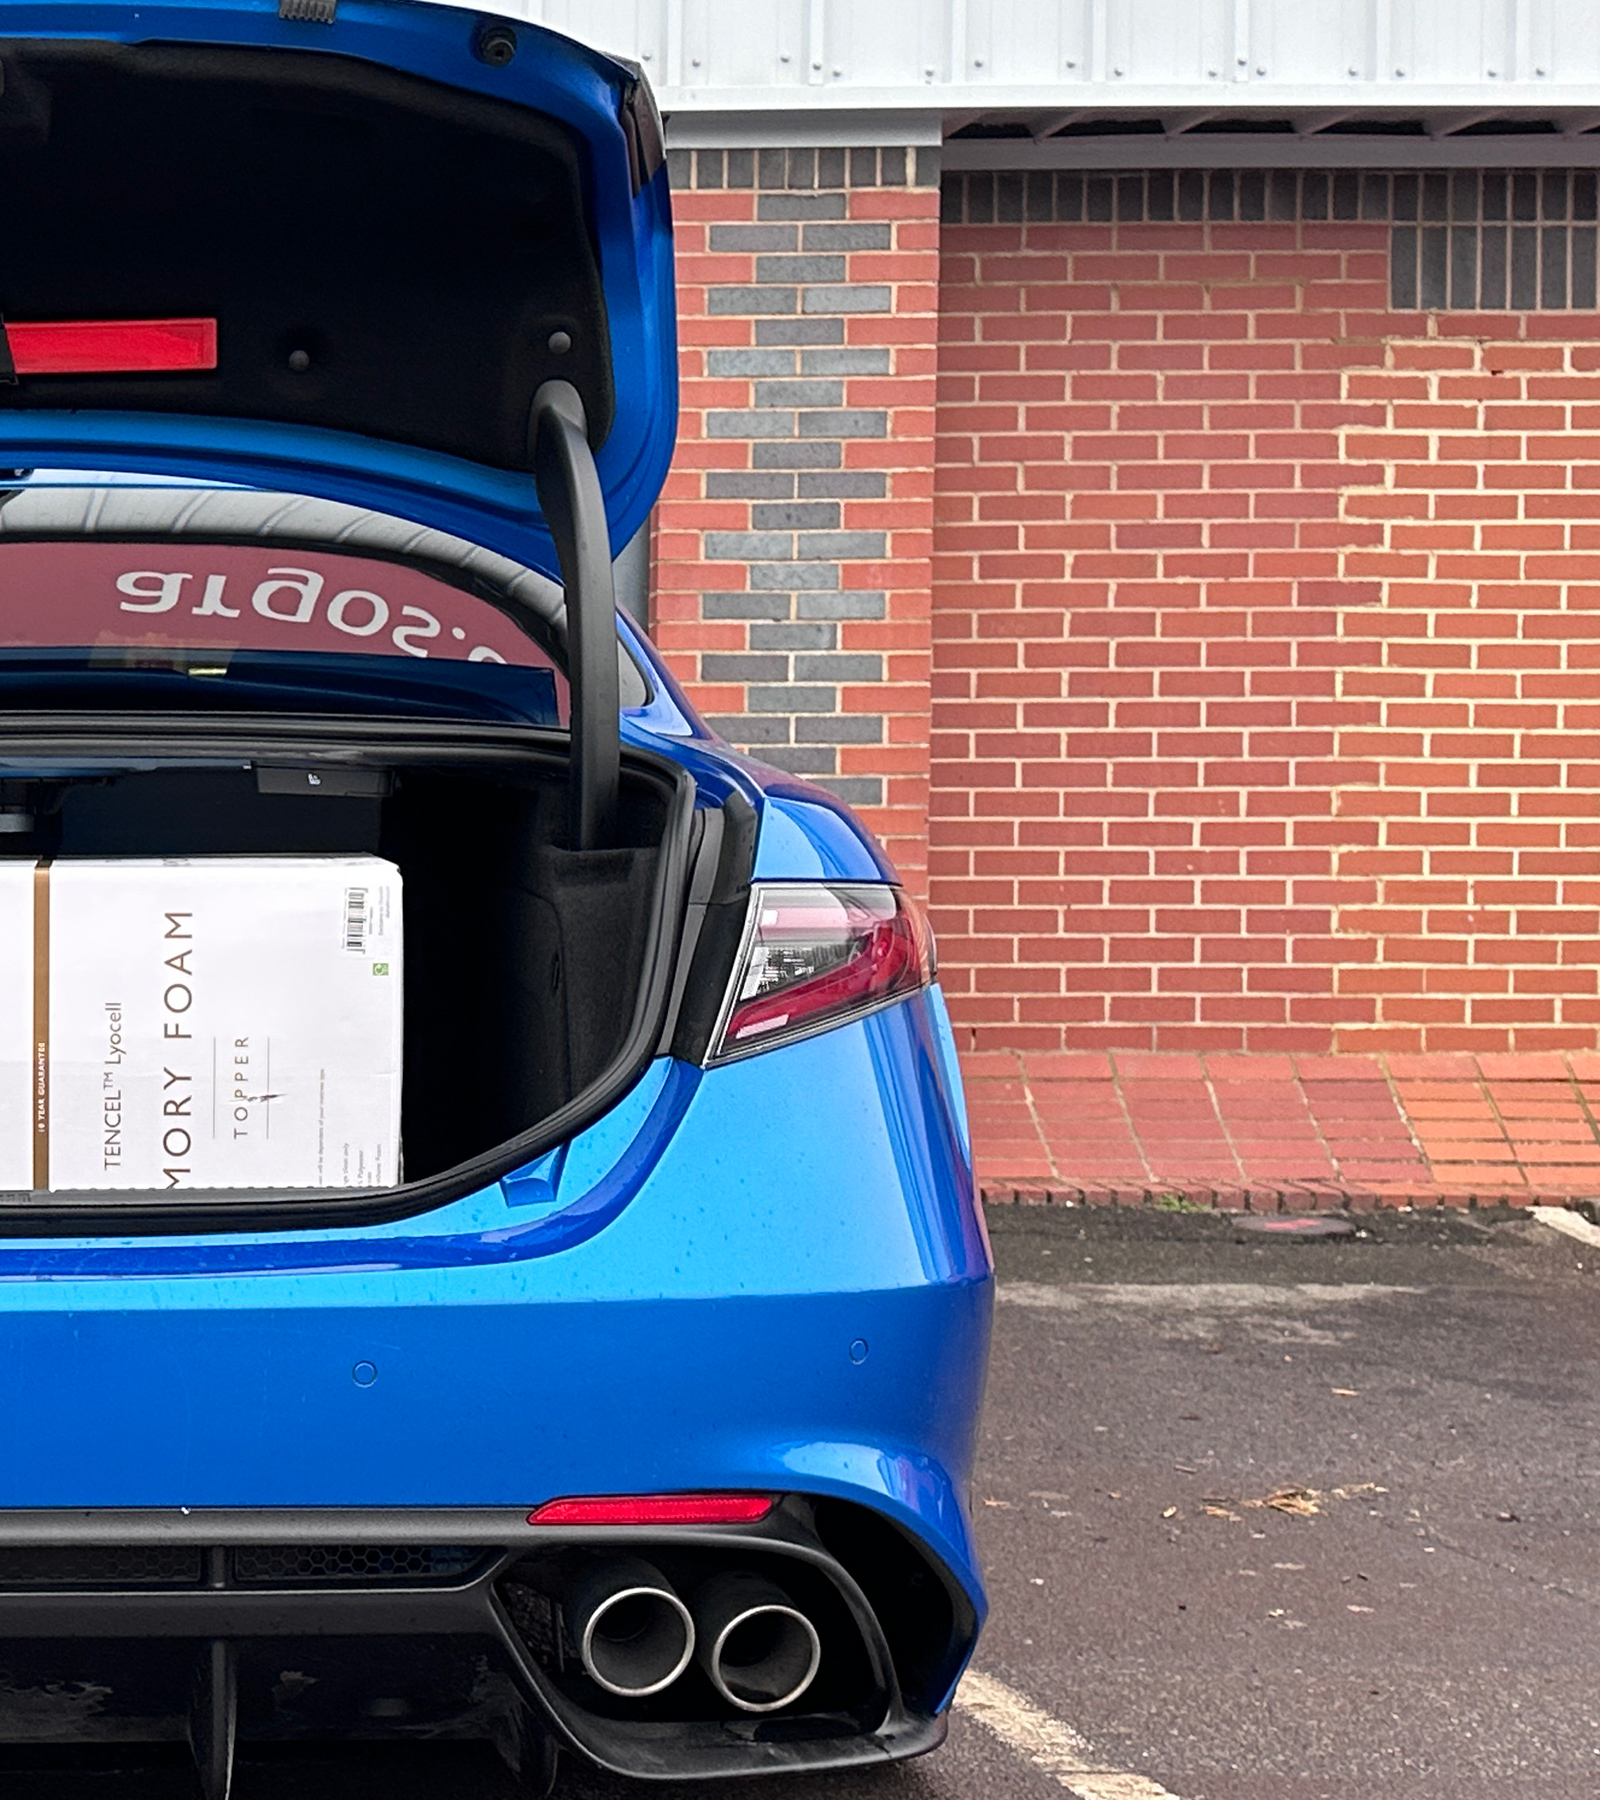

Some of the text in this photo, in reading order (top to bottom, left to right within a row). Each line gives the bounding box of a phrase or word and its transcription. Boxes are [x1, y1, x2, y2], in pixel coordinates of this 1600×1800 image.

[163, 911, 193, 1039] FOAM
[104, 1002, 127, 1065] Lyocell
[37, 1041, 46, 1096] GUARANTEE
[233, 1037, 249, 1140] TOPPER
[37, 1098, 46, 1121] YEAR
